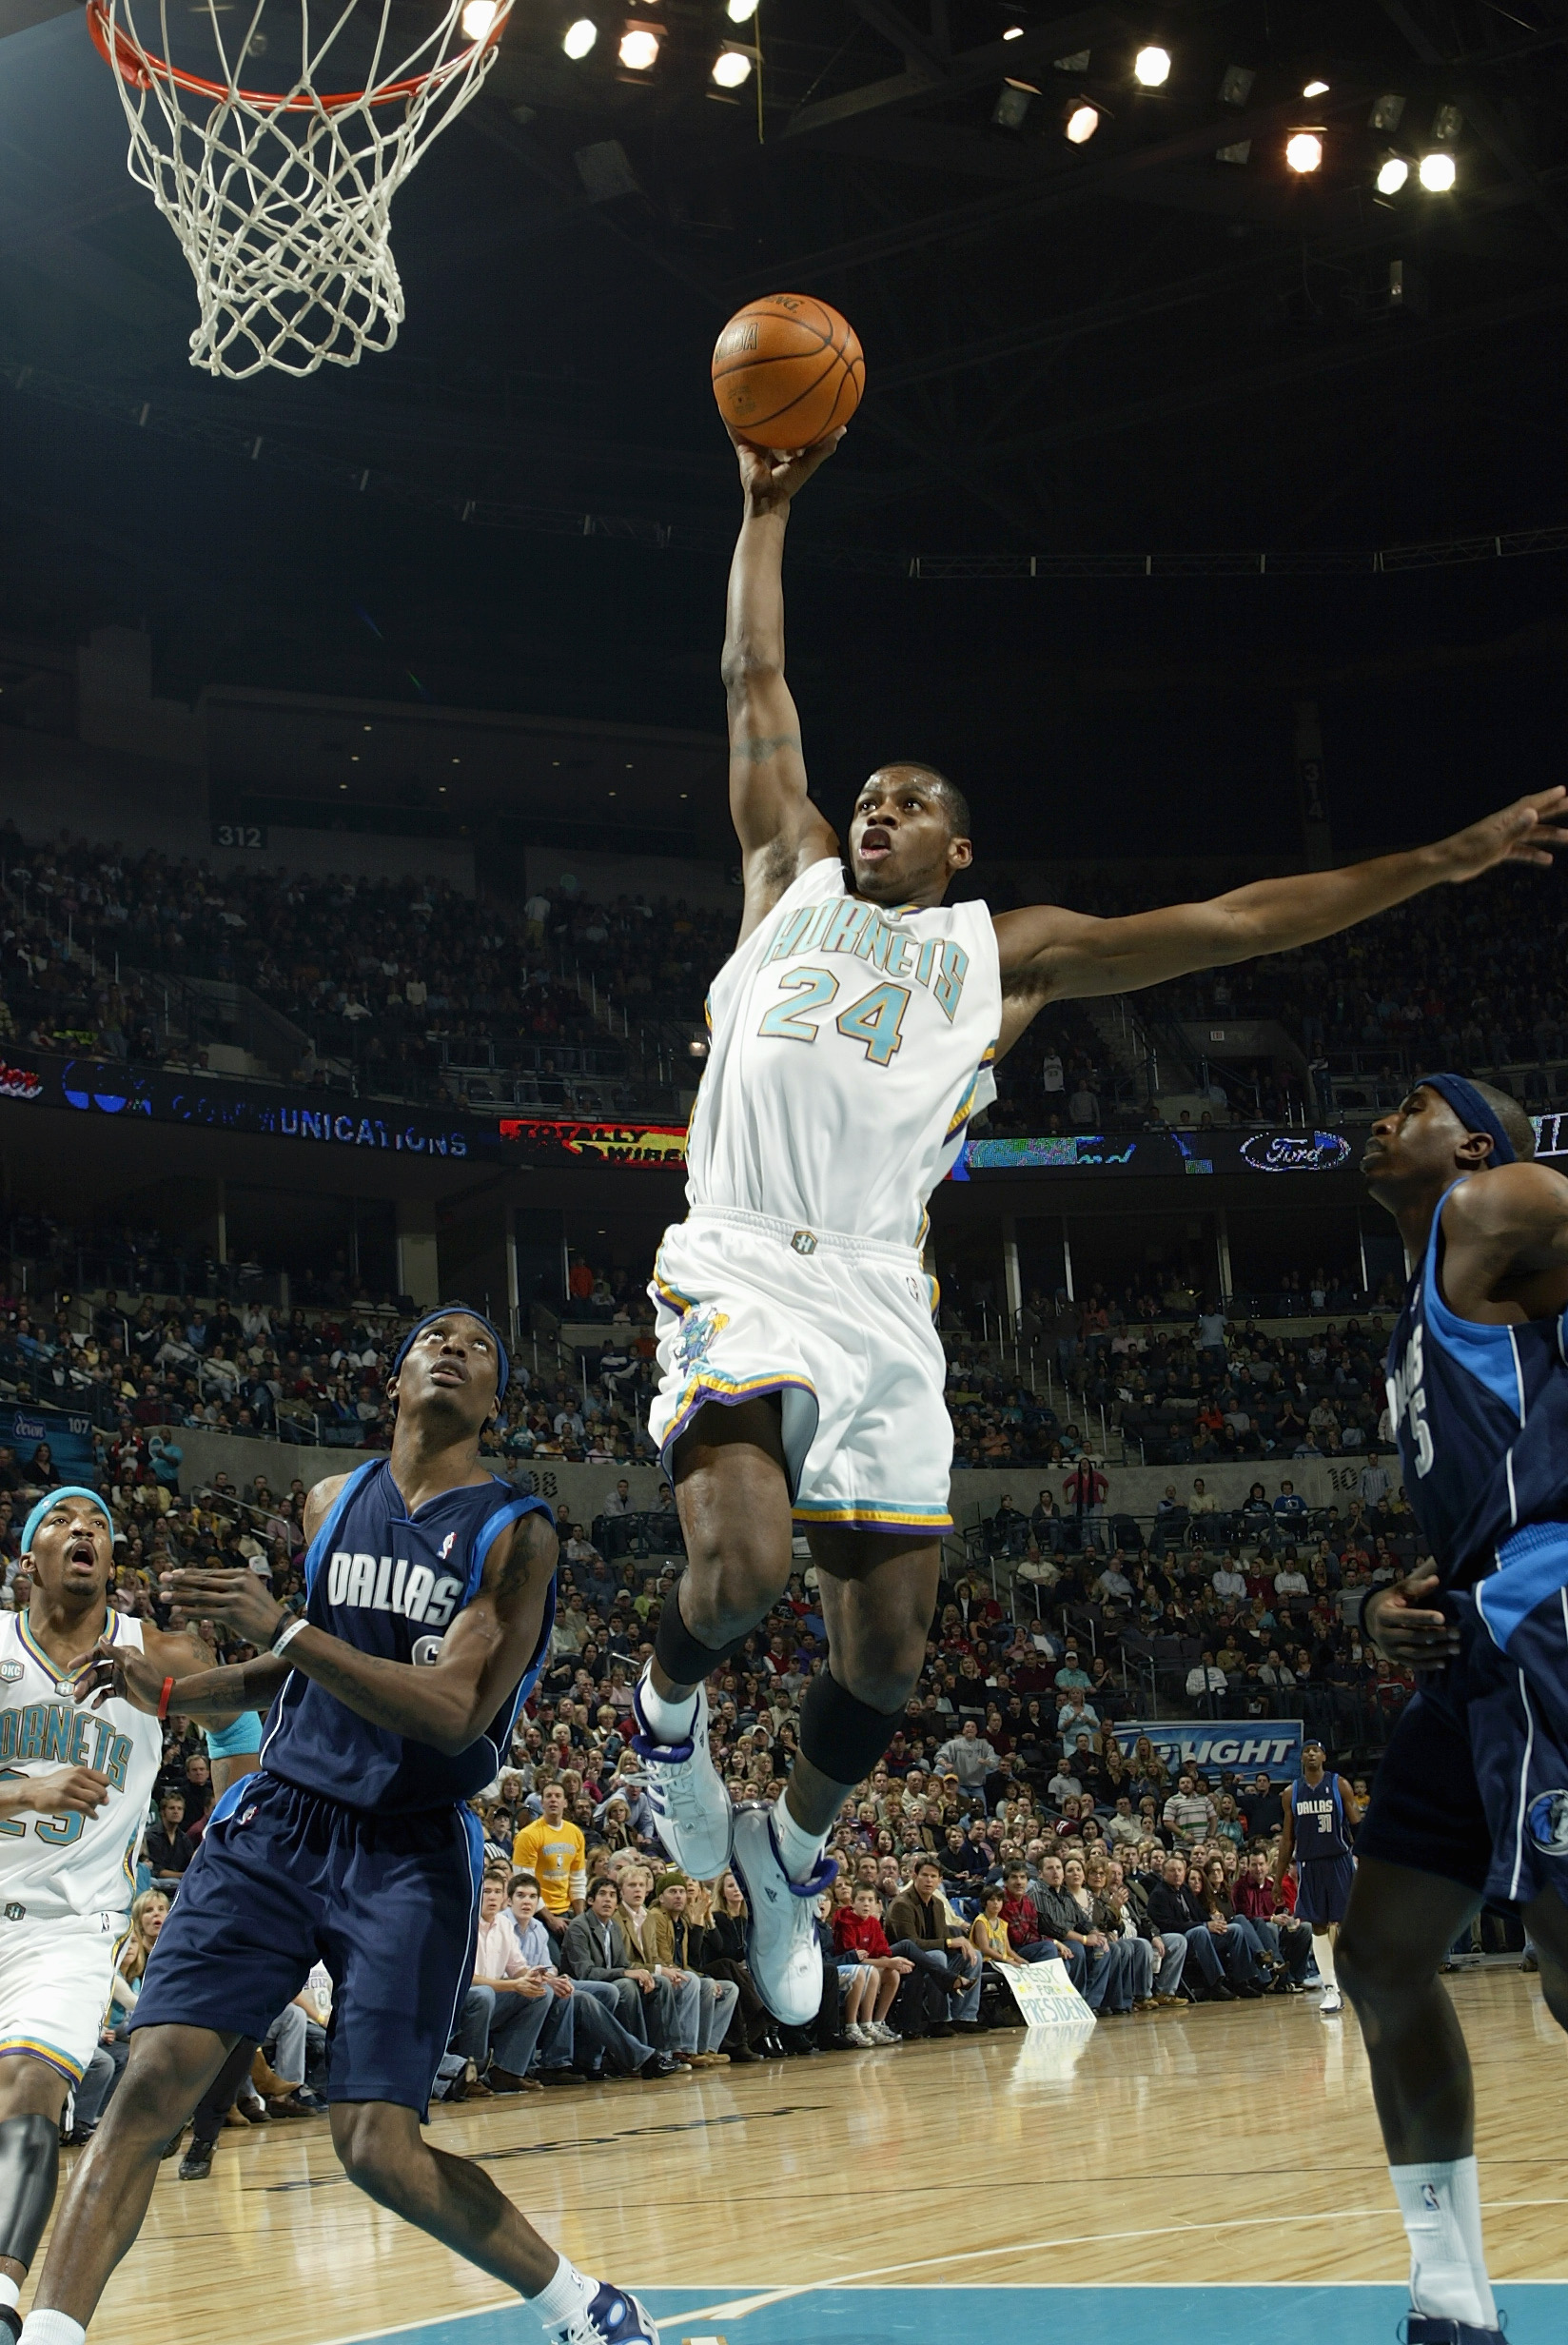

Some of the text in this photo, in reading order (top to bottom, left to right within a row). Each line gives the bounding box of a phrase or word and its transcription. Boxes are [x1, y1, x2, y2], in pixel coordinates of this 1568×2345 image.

[219, 825, 262, 848] 312
[757, 897, 970, 1024] HORNETS
[757, 966, 912, 1067] 24
[1266, 1137, 1324, 1163] Ford
[69, 1417, 89, 1434] 107
[1326, 1467, 1358, 1491] 10
[327, 1552, 464, 1626] DALLAS
[1, 1664, 21, 1677] OKC
[0, 1705, 134, 1793] ORNETS
[1297, 1800, 1333, 1816] DALLAS
[1317, 1814, 1332, 1833] 31
[1004, 1965, 1060, 1983] SPEEDY
[1035, 1984, 1058, 1996] FOR
[1019, 1996, 1094, 2025] PRESIDENT
